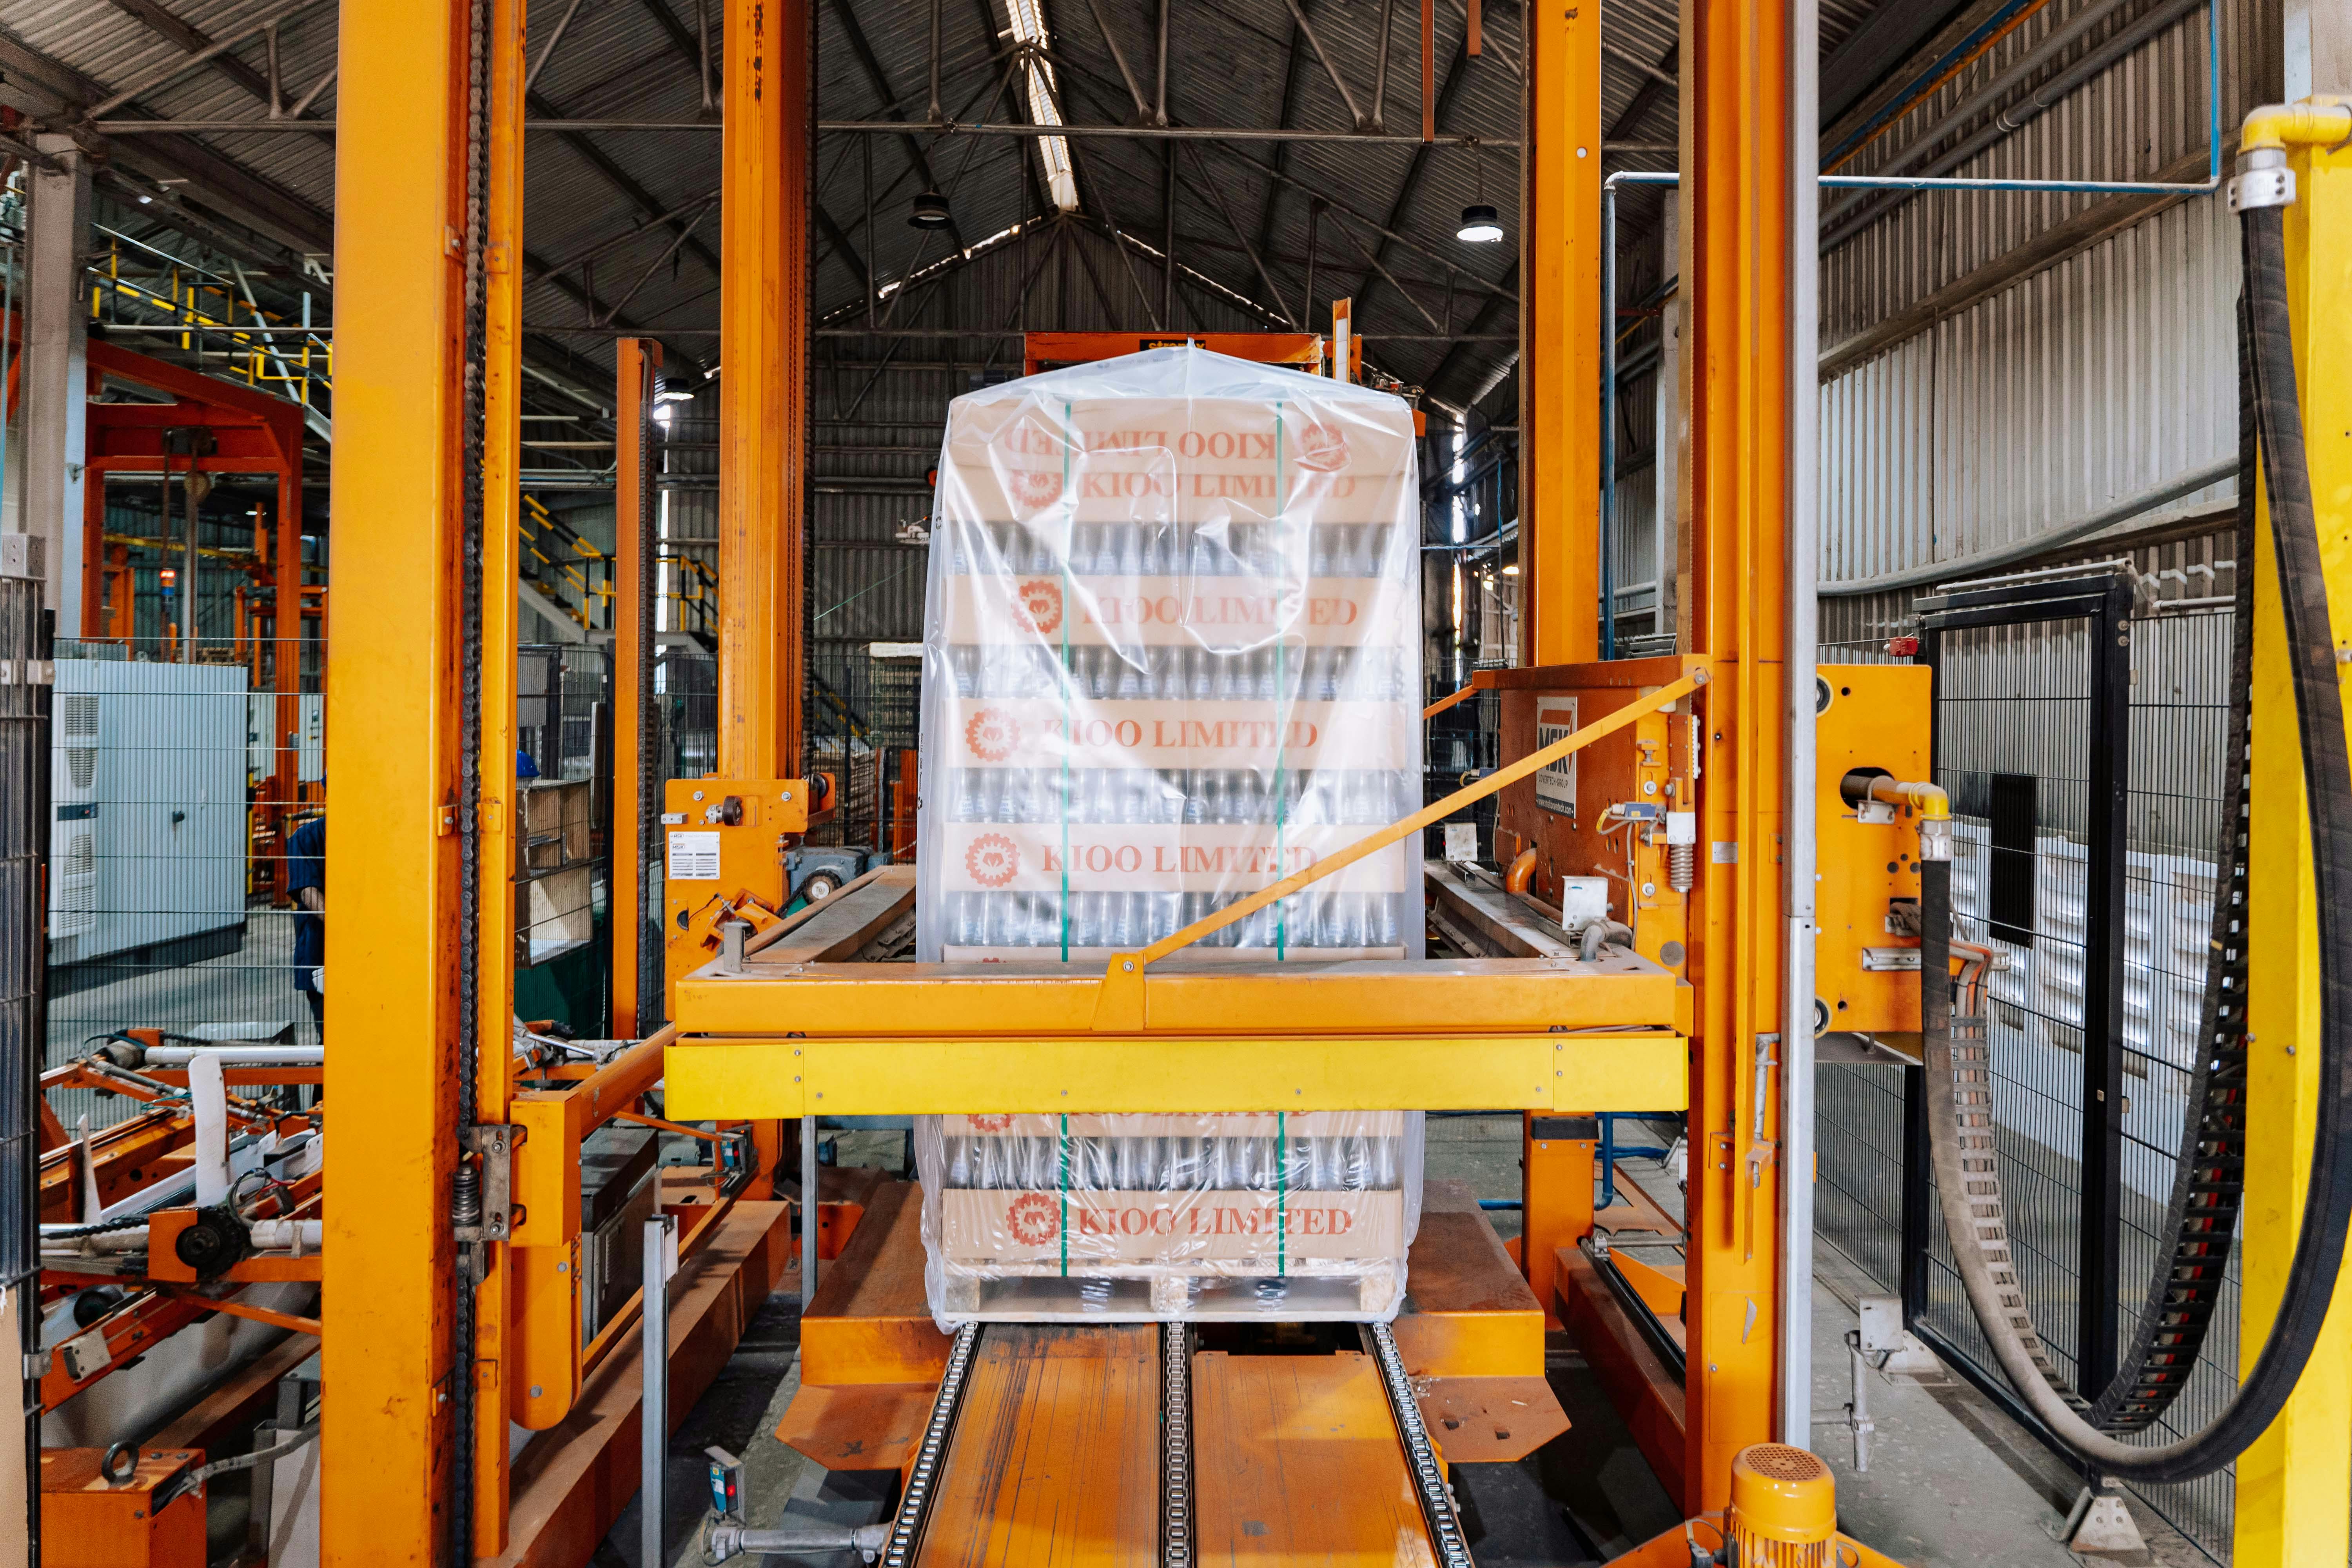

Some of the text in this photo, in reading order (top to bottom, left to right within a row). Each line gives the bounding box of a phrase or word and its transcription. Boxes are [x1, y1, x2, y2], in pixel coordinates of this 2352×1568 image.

[1178, 431, 1277, 459] KIOO
[1082, 473, 1181, 498] KIOO
[1193, 596, 1358, 626] LIMIED
[1041, 719, 1142, 747] KIOO
[1539, 727, 1569, 775] MSK
[1041, 845, 1318, 873] KIOO LIMITED
[1078, 1207, 1353, 1236] KIOO LIMITED
